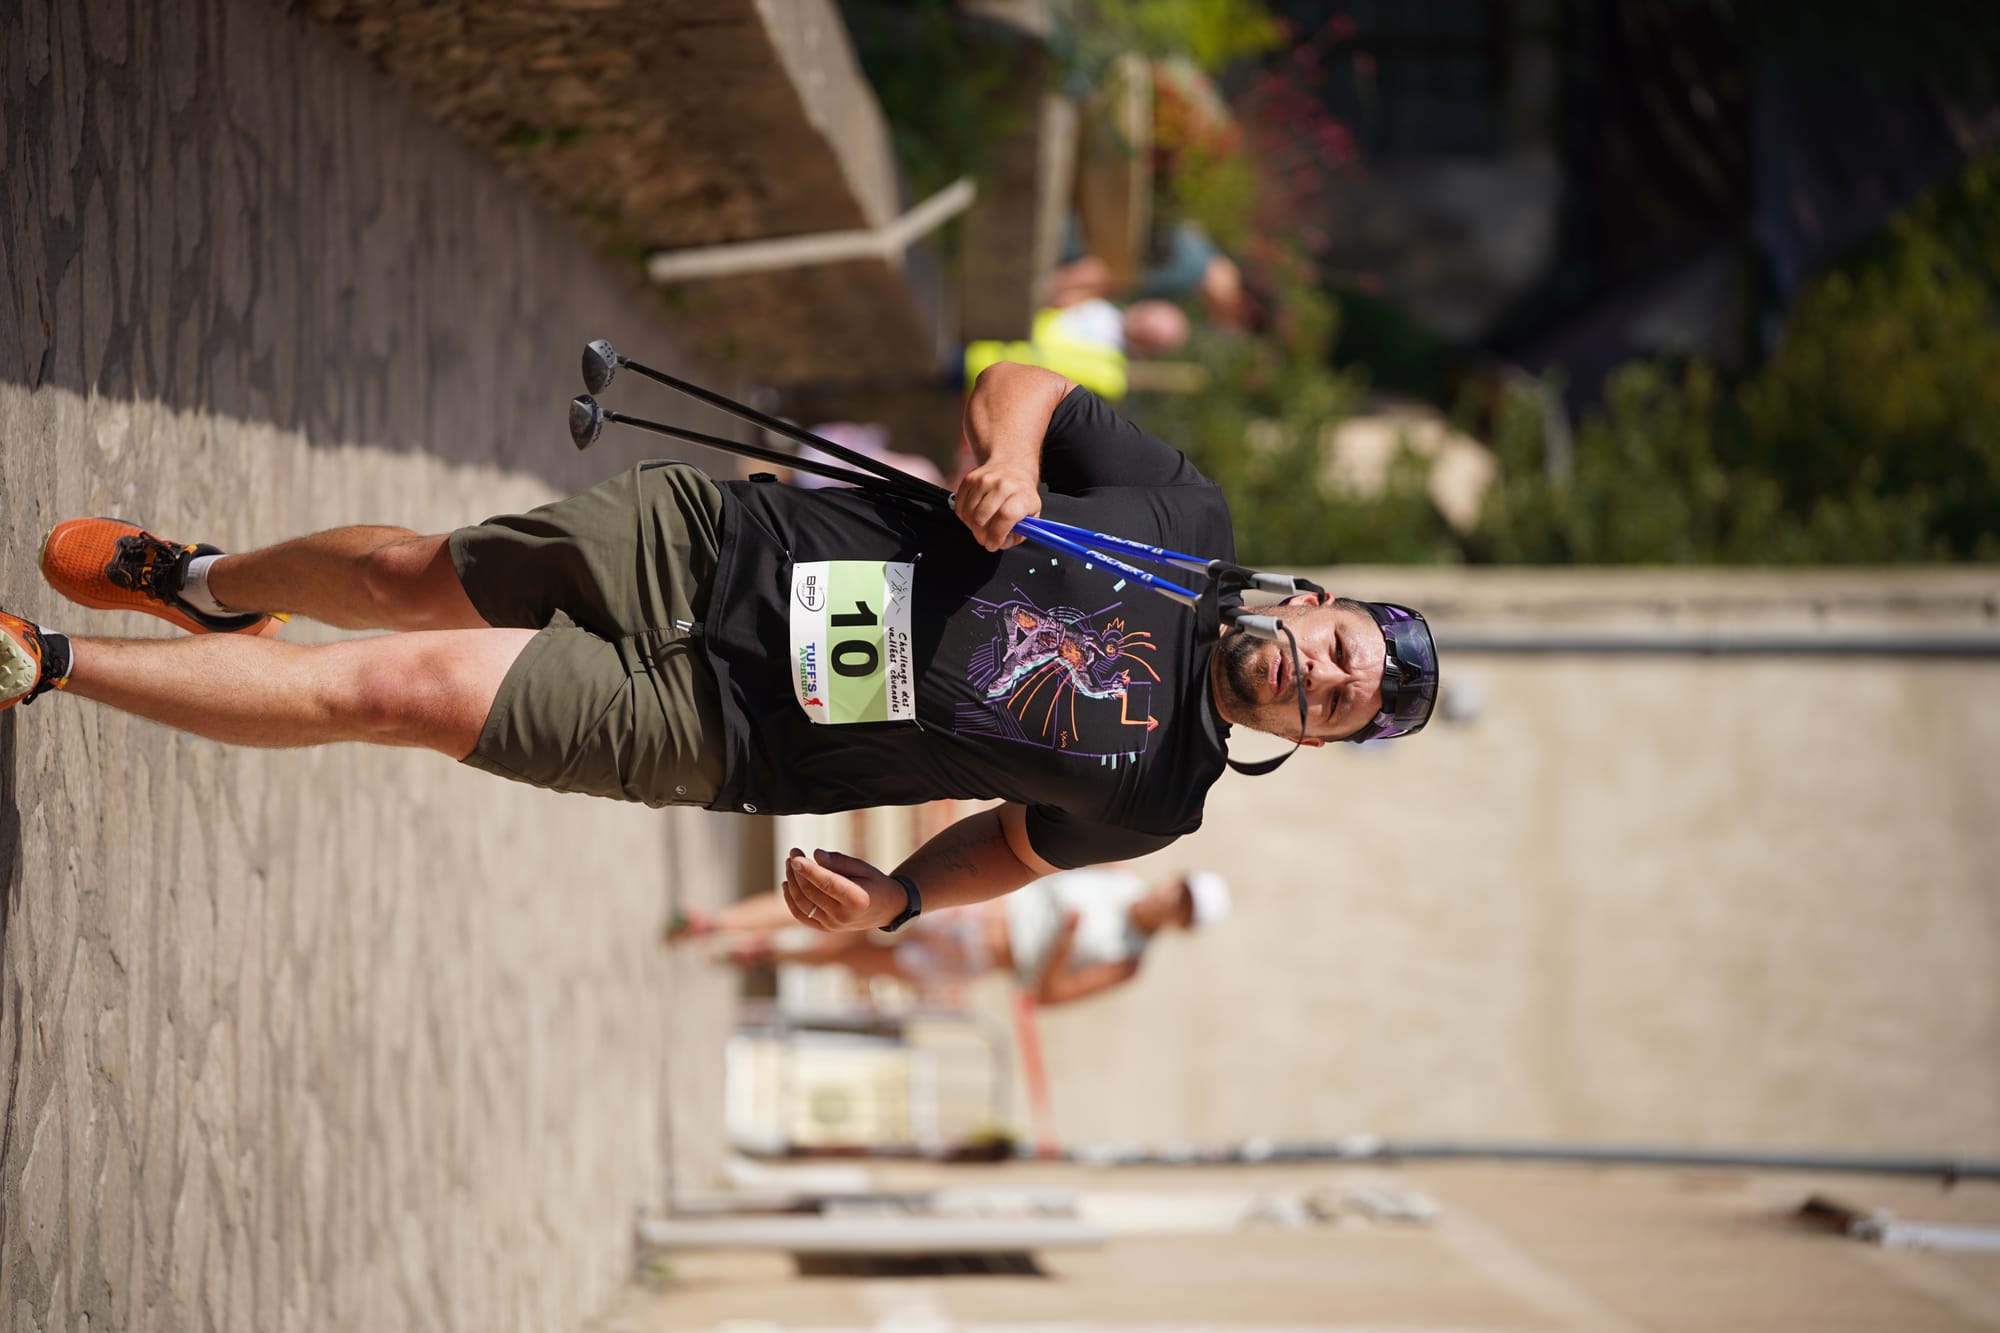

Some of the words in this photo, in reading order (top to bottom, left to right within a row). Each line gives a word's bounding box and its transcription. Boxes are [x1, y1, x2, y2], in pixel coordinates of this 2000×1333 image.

[806, 575, 816, 607] BFP
[830, 600, 879, 678] 10
[888, 626, 897, 664] vallées
[898, 632, 908, 685] Challenge
[799, 647, 809, 697] Aventure
[805, 642, 817, 693] TUFF'S
[889, 669, 900, 713] cévenoles
